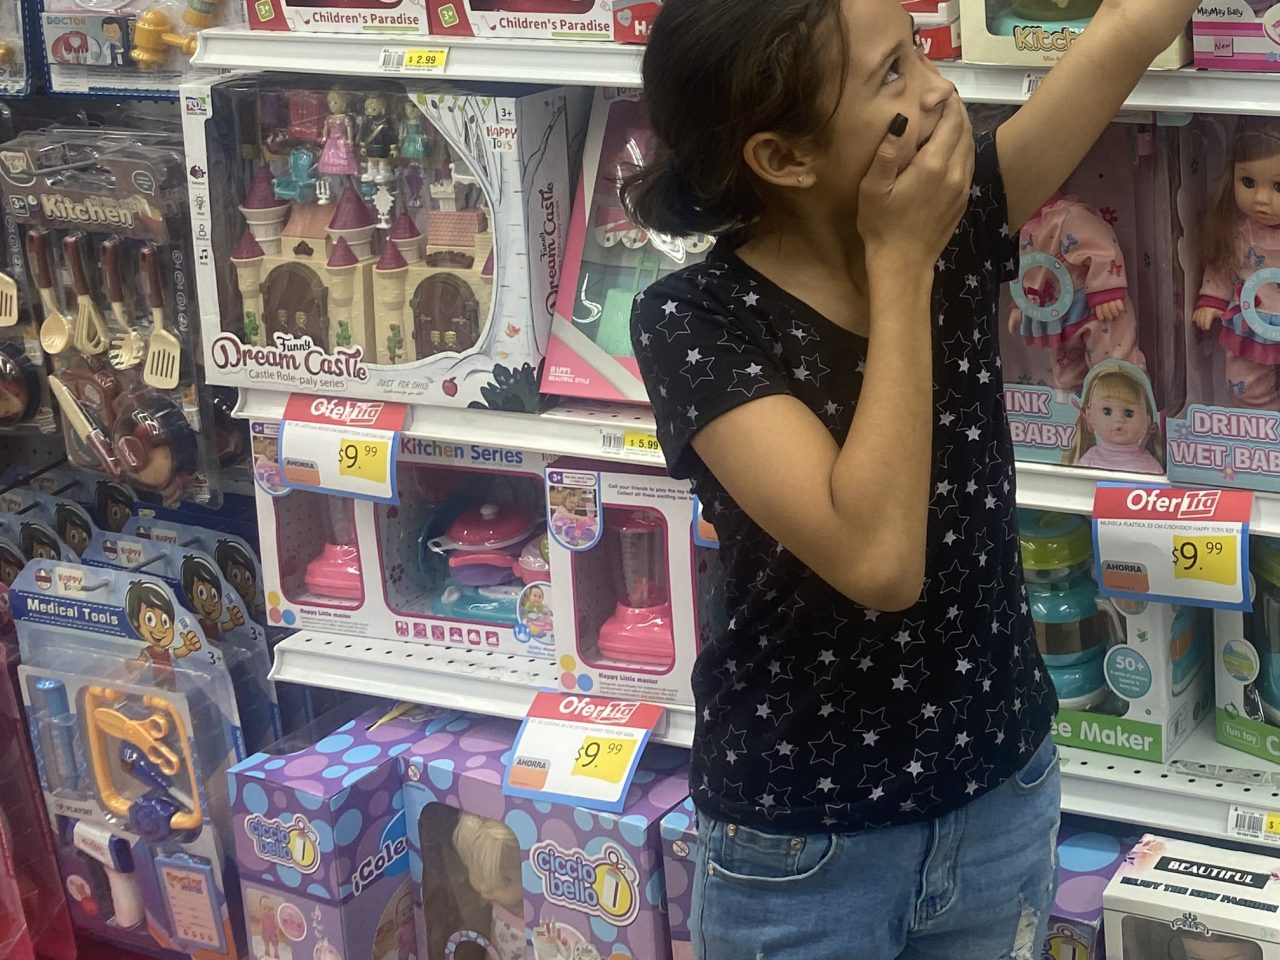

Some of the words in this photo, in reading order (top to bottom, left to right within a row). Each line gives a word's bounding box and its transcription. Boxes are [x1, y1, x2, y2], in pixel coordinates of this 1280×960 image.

[313, 11, 368, 25] Children's
[371, 13, 420, 26] Paradise
[43, 194, 135, 228] Kitchen
[277, 336, 311, 353] Funny
[212, 337, 301, 370] Dream
[304, 349, 367, 381] Castle
[249, 369, 275, 381] Castle
[320, 378, 345, 389] series
[1192, 410, 1280, 441] DRINK
[400, 438, 464, 461] Kitchen
[471, 443, 523, 464] Series
[1169, 439, 1229, 468] WET
[1106, 562, 1142, 574] AHORRA
[27, 597, 79, 618] Medical
[84, 608, 119, 625] Tools
[1226, 725, 1241, 738] fun
[1243, 728, 1257, 744] toy
[516, 758, 547, 769] AHORRA
[537, 851, 597, 882] ciccio
[1167, 860, 1254, 884] BEAUTIFUL
[550, 876, 598, 907] bello
